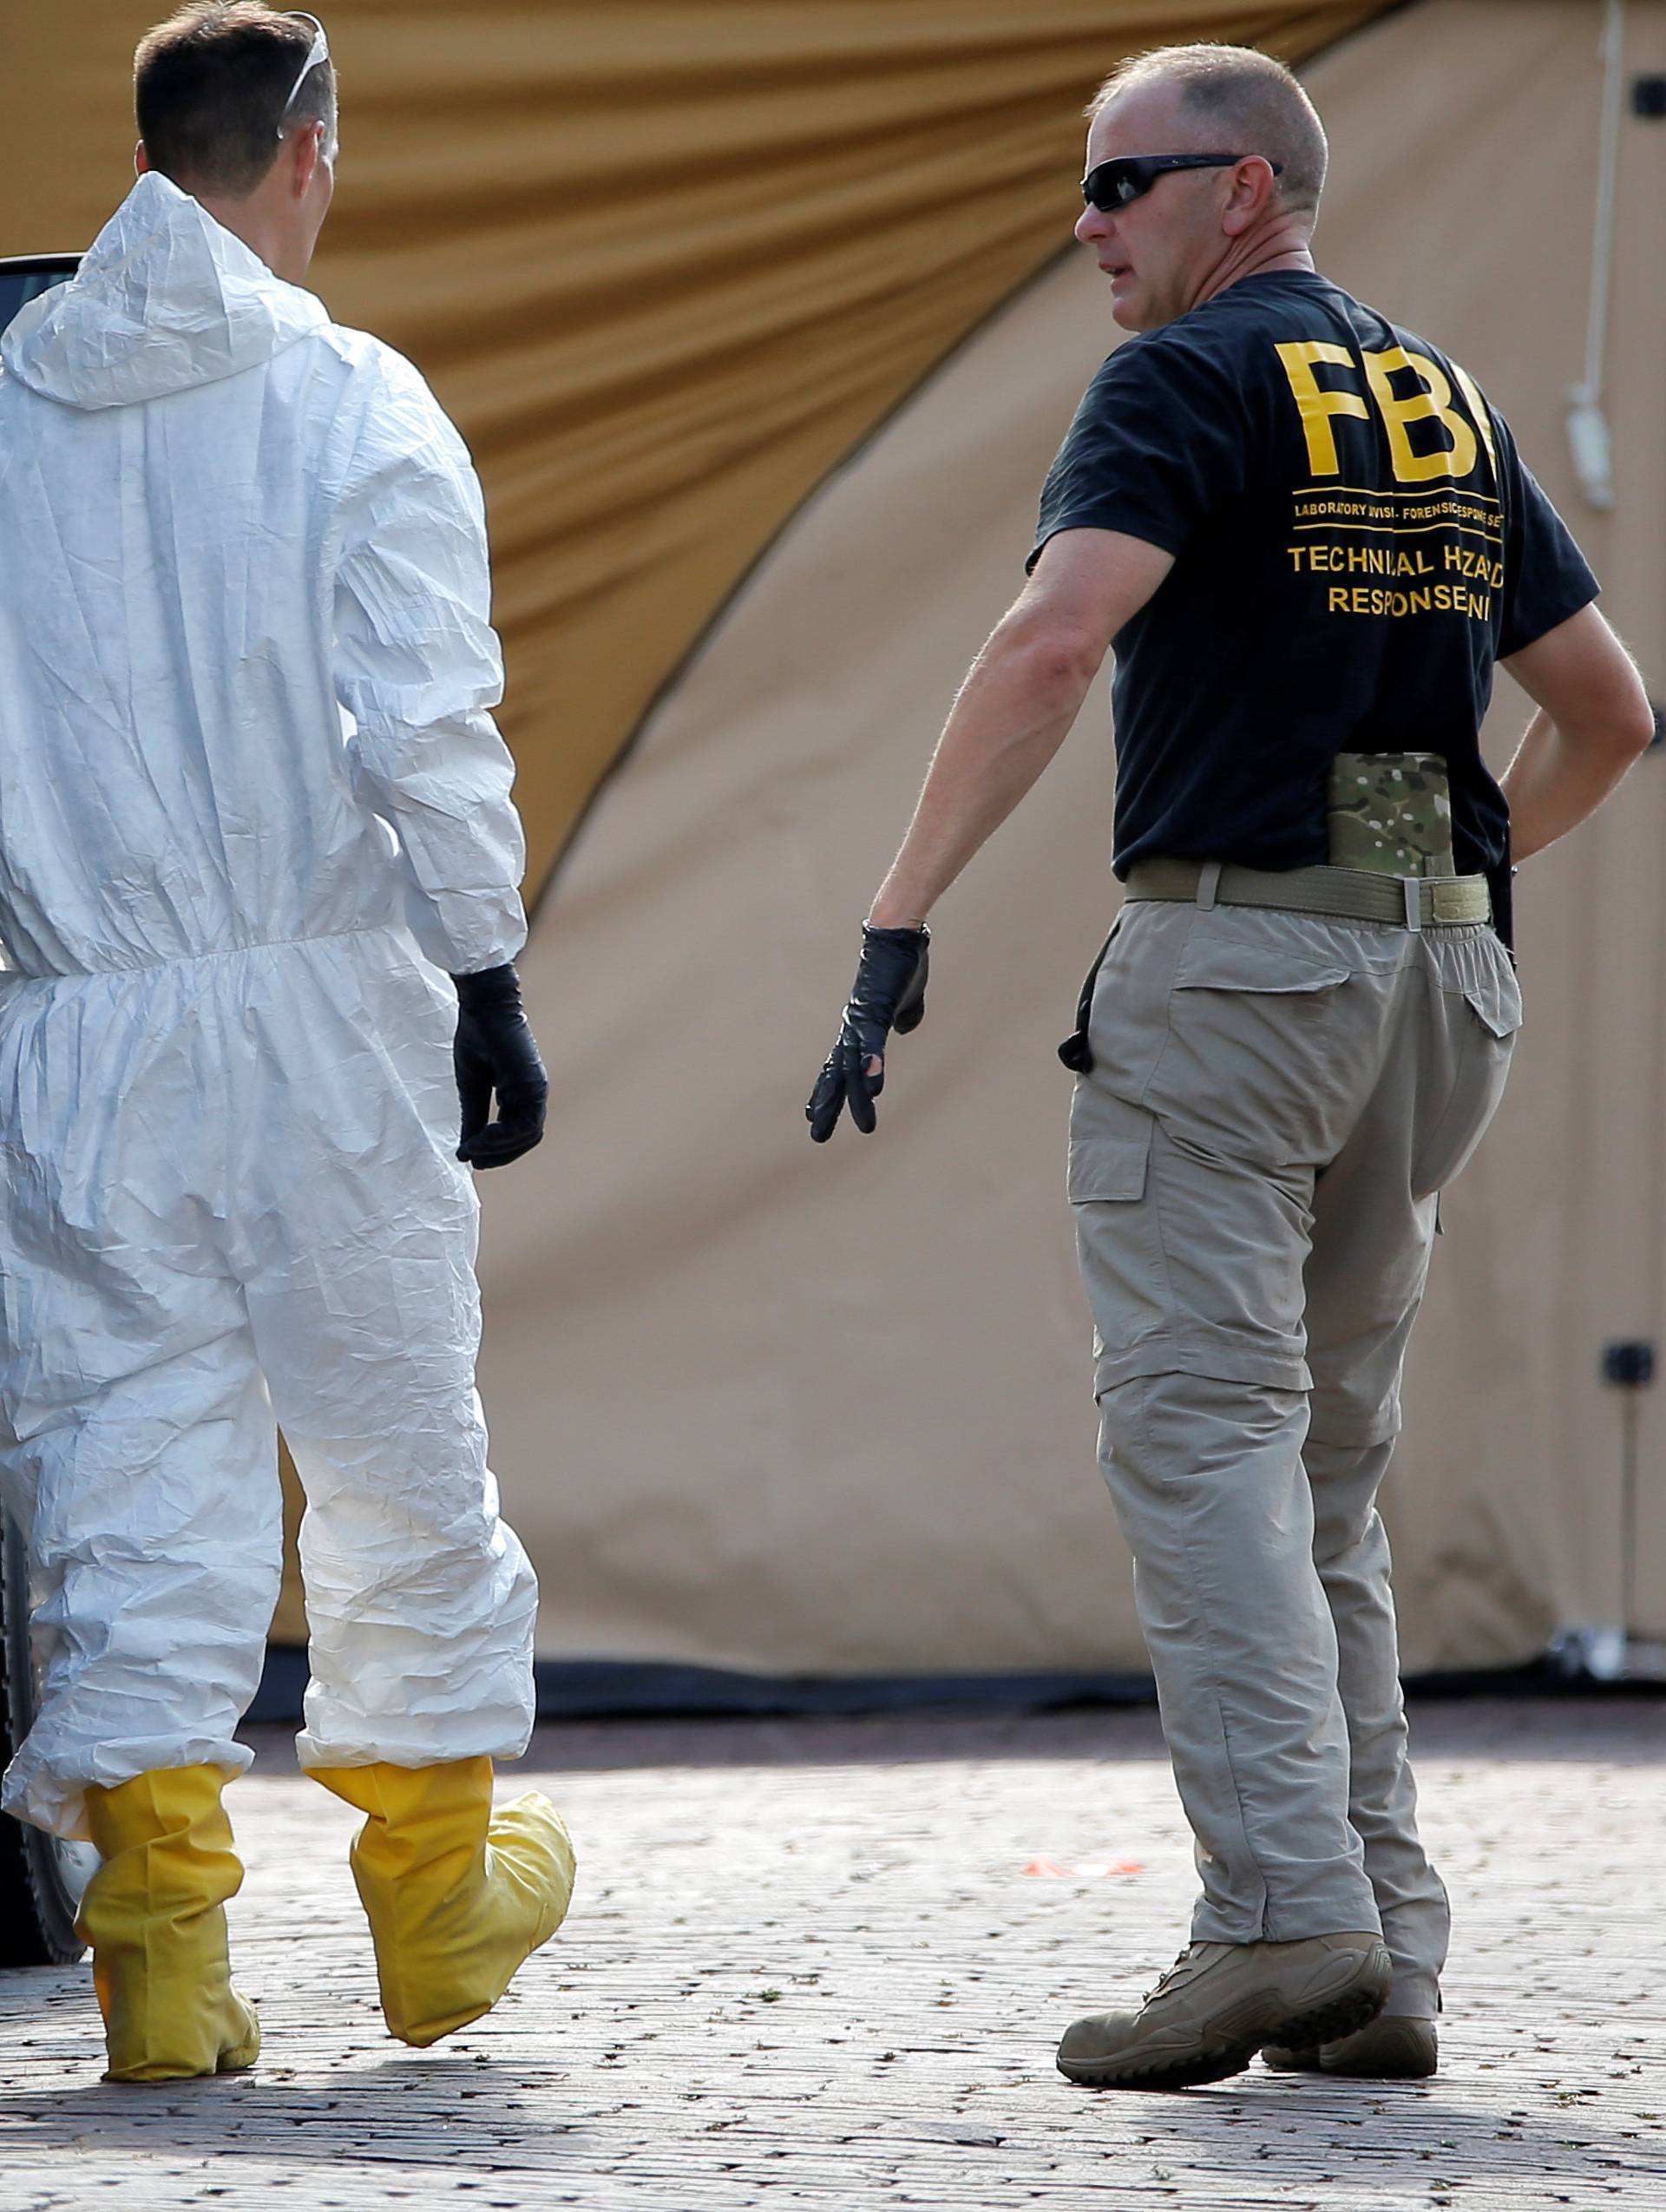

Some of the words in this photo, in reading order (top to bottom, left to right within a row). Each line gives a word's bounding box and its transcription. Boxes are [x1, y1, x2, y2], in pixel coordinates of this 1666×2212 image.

[1275, 341, 1498, 482] FBI
[1402, 502, 1458, 520] FORENSIC
[1444, 545, 1504, 589] HZAD
[1328, 585, 1467, 617] RESPONSE
